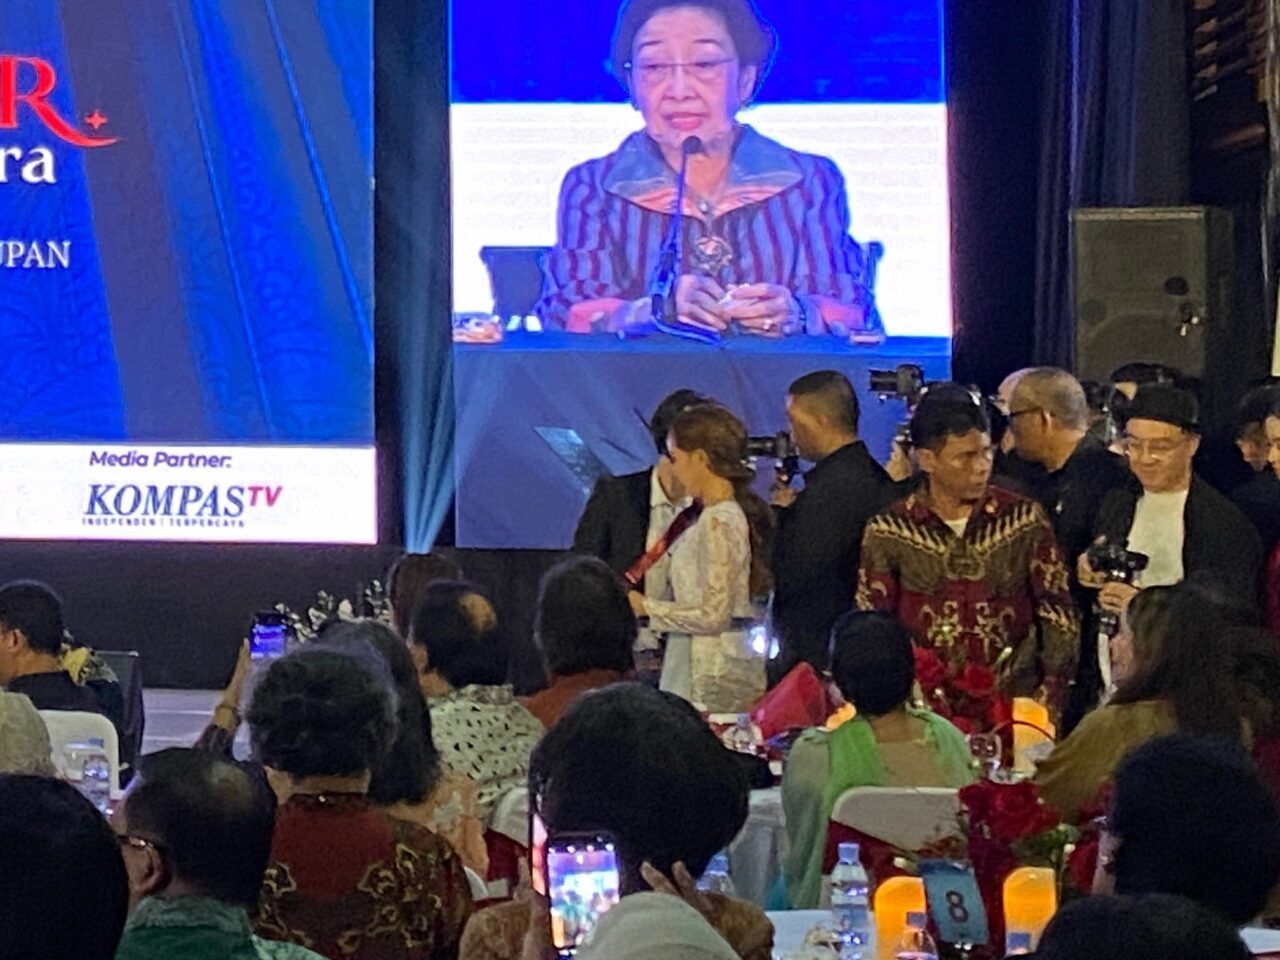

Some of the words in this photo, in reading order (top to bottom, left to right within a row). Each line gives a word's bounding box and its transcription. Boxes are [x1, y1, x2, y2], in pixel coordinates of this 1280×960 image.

[89, 450, 149, 467] Media
[153, 451, 233, 468] Partner:
[945, 890, 969, 923] 8
